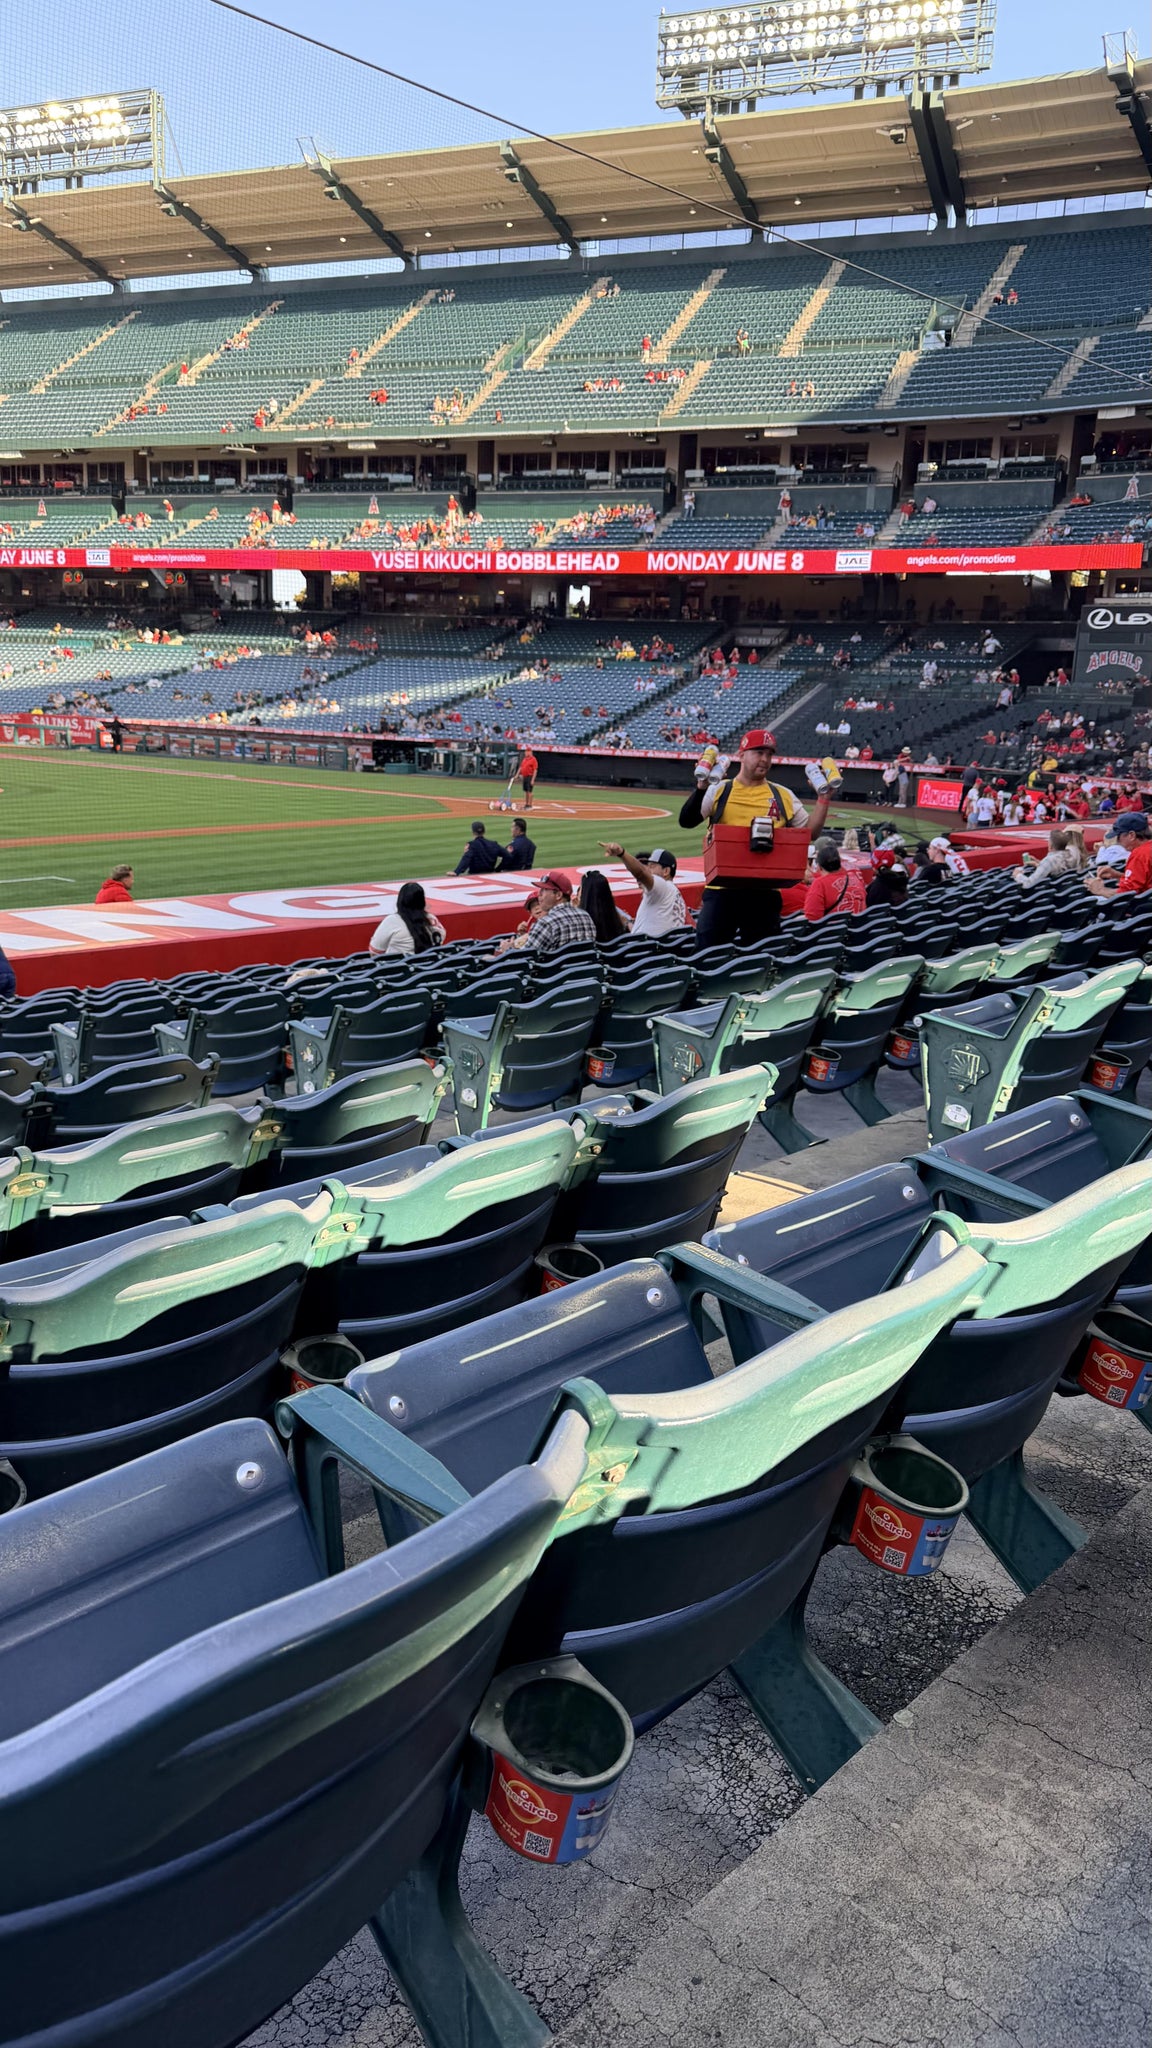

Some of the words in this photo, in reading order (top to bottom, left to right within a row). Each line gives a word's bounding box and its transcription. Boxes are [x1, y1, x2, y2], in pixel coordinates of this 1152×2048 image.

[19, 550, 54, 565] JUNE
[57, 550, 66, 565] 8
[132, 553, 206, 563] angels.com/promotions
[371, 551, 419, 568] YUSEI
[422, 552, 491, 570] KIKUCHI
[495, 553, 620, 571] BOBBLEHEAD
[647, 552, 730, 571] MONDAY
[733, 552, 786, 571] JUNE
[791, 552, 804, 571] 8
[838, 556, 869, 565] JAE
[906, 553, 1017, 567] angels.com/promotions
[1086, 650, 1143, 673] ANGELS
[920, 782, 962, 806] ANGEL
[767, 797, 780, 821] A
